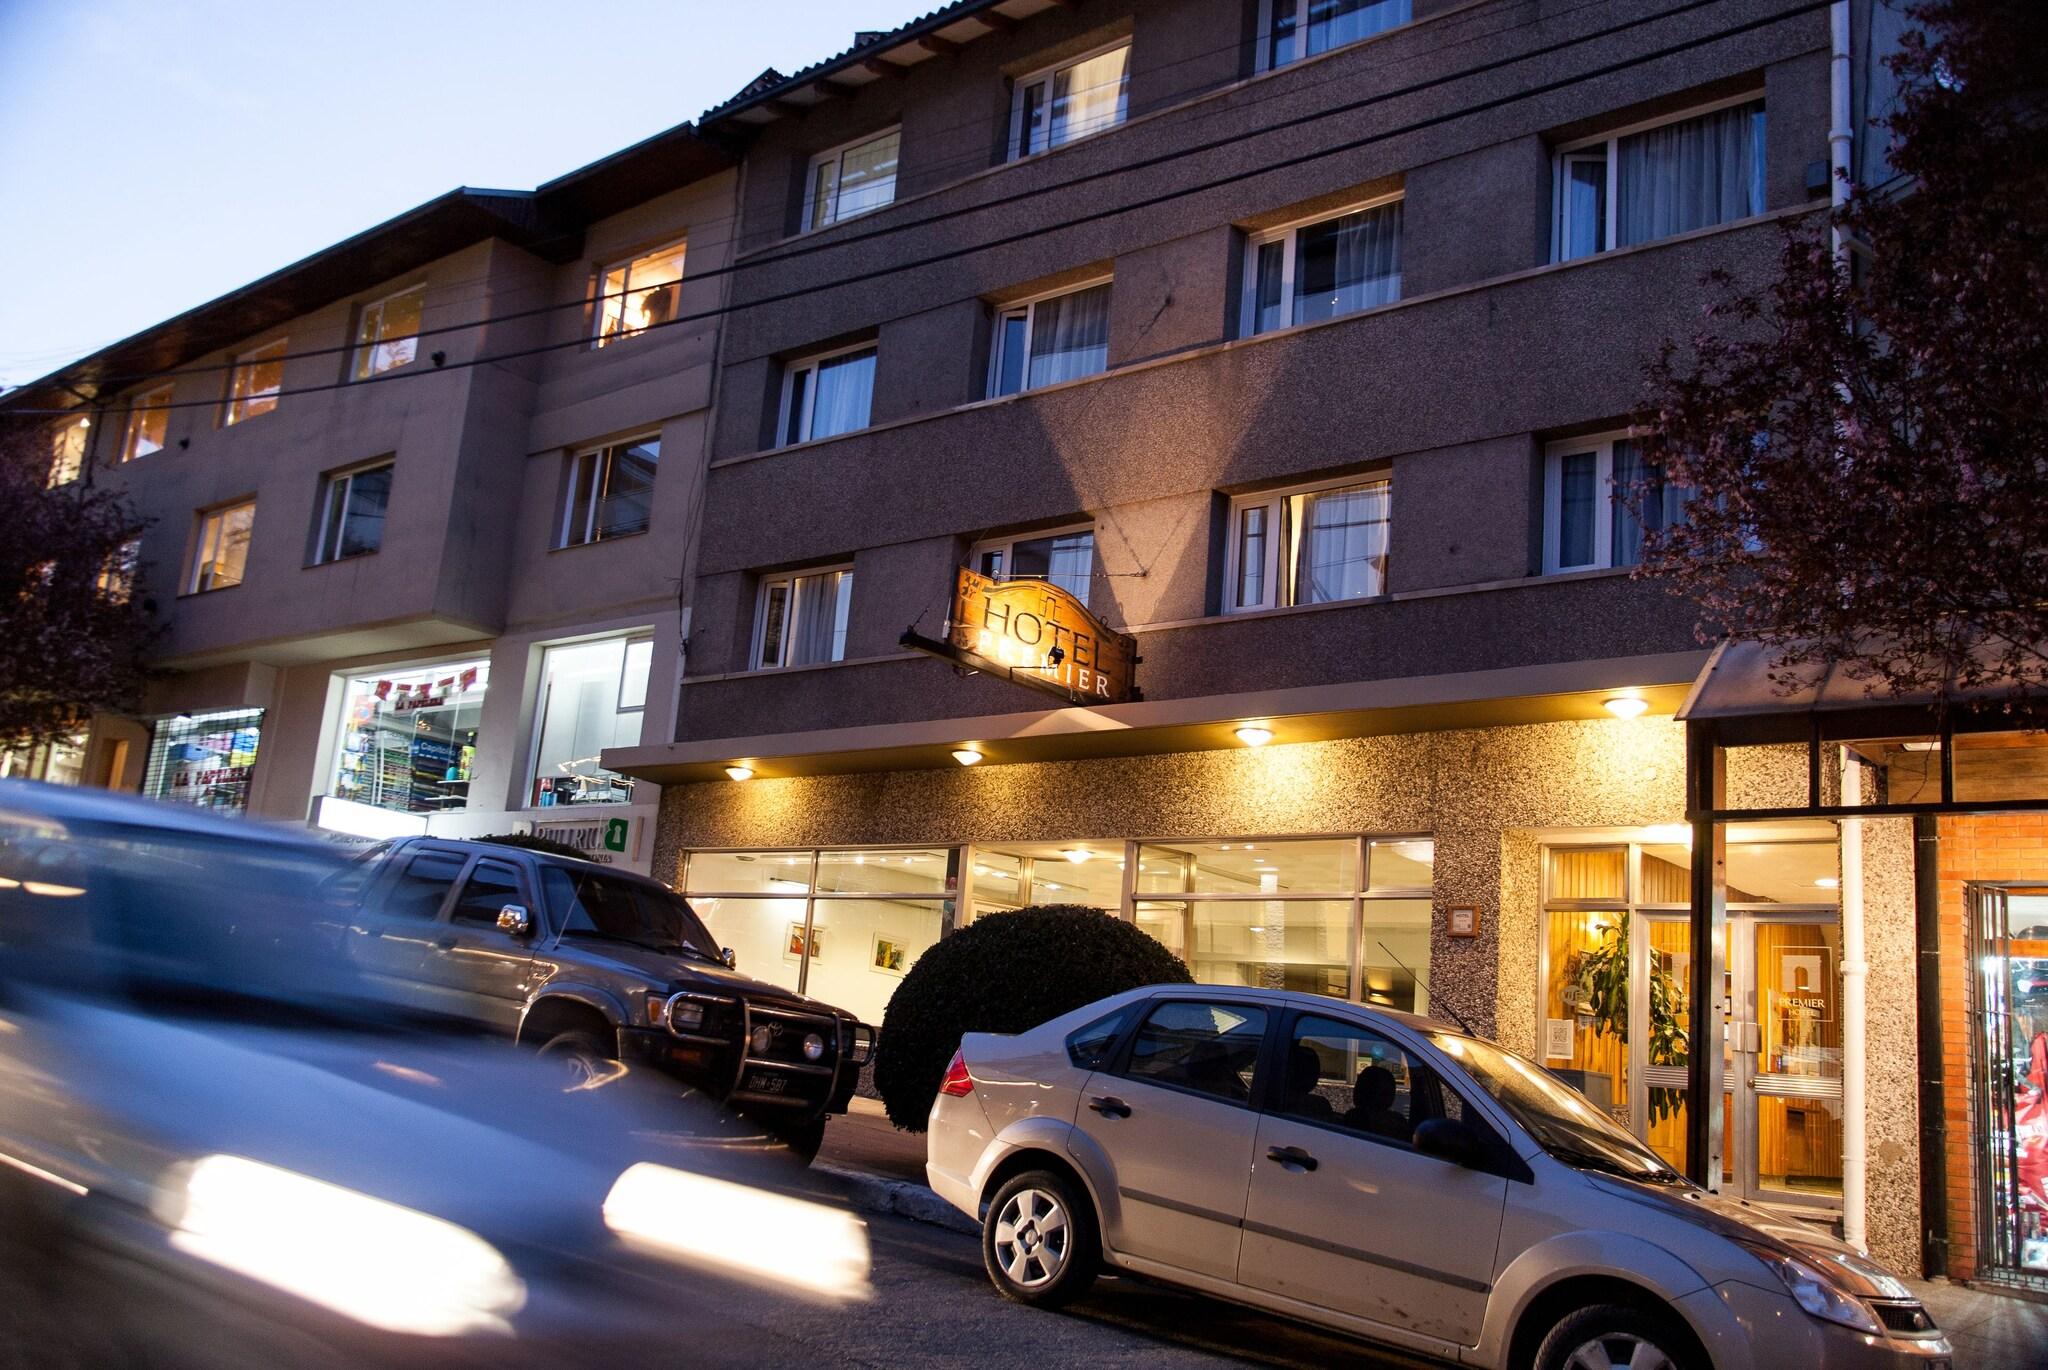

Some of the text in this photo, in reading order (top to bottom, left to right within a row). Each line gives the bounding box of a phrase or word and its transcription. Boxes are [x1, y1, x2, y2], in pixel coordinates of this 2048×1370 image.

[984, 596, 1111, 675] HOTEL
[1778, 998, 1826, 1009] PREMIER
[1788, 1009, 1816, 1017] HOTEL
